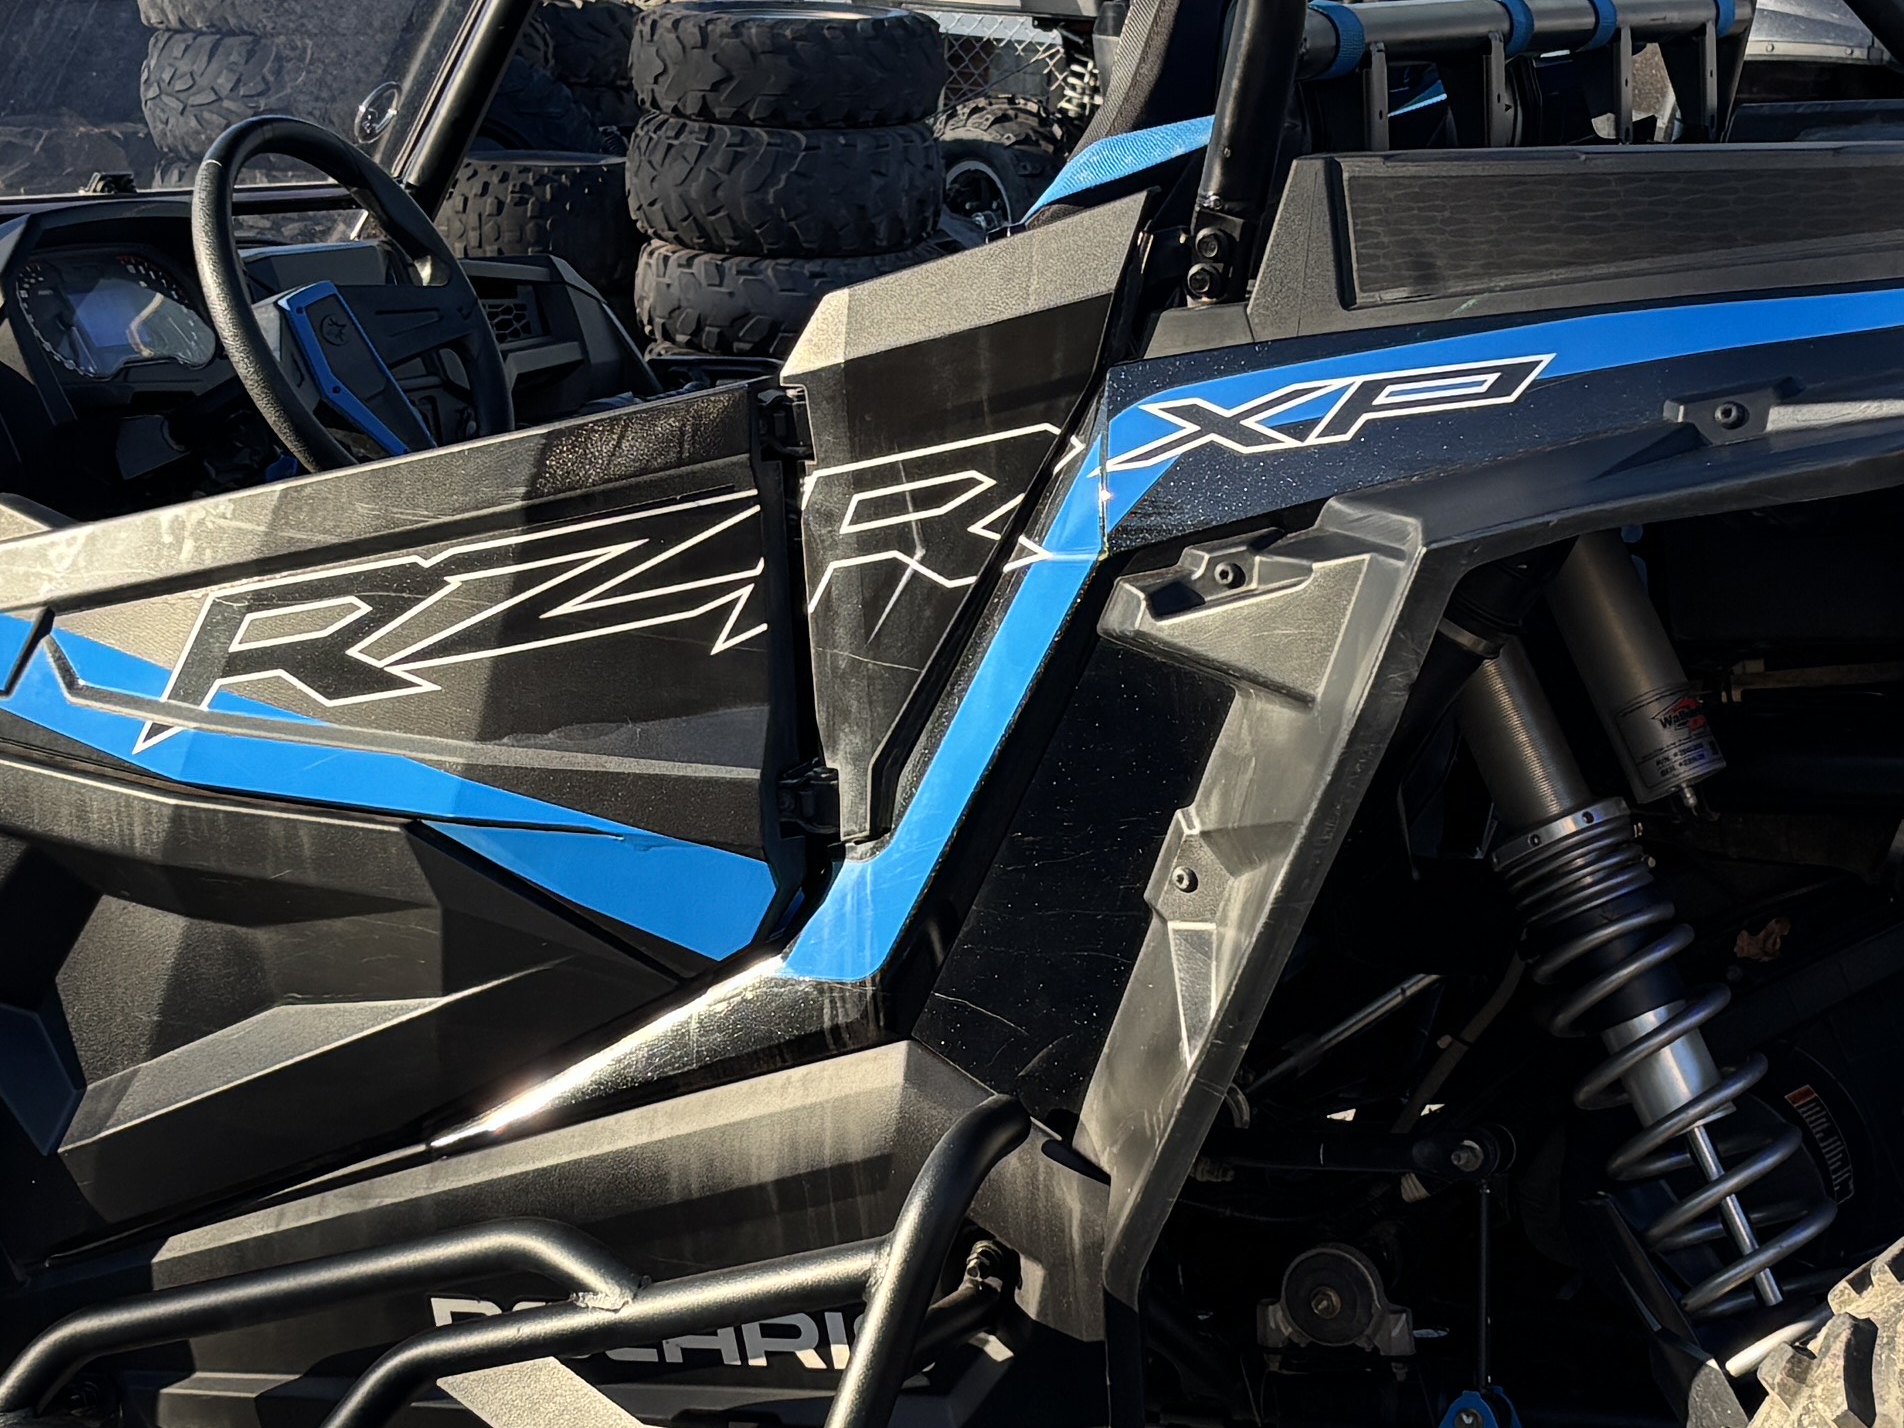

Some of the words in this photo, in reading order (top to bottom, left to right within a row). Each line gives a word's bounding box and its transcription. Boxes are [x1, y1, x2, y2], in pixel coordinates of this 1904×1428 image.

[1089, 352, 1557, 477] XP
[133, 422, 1085, 754] RZR
[429, 1296, 865, 1370] LARI
